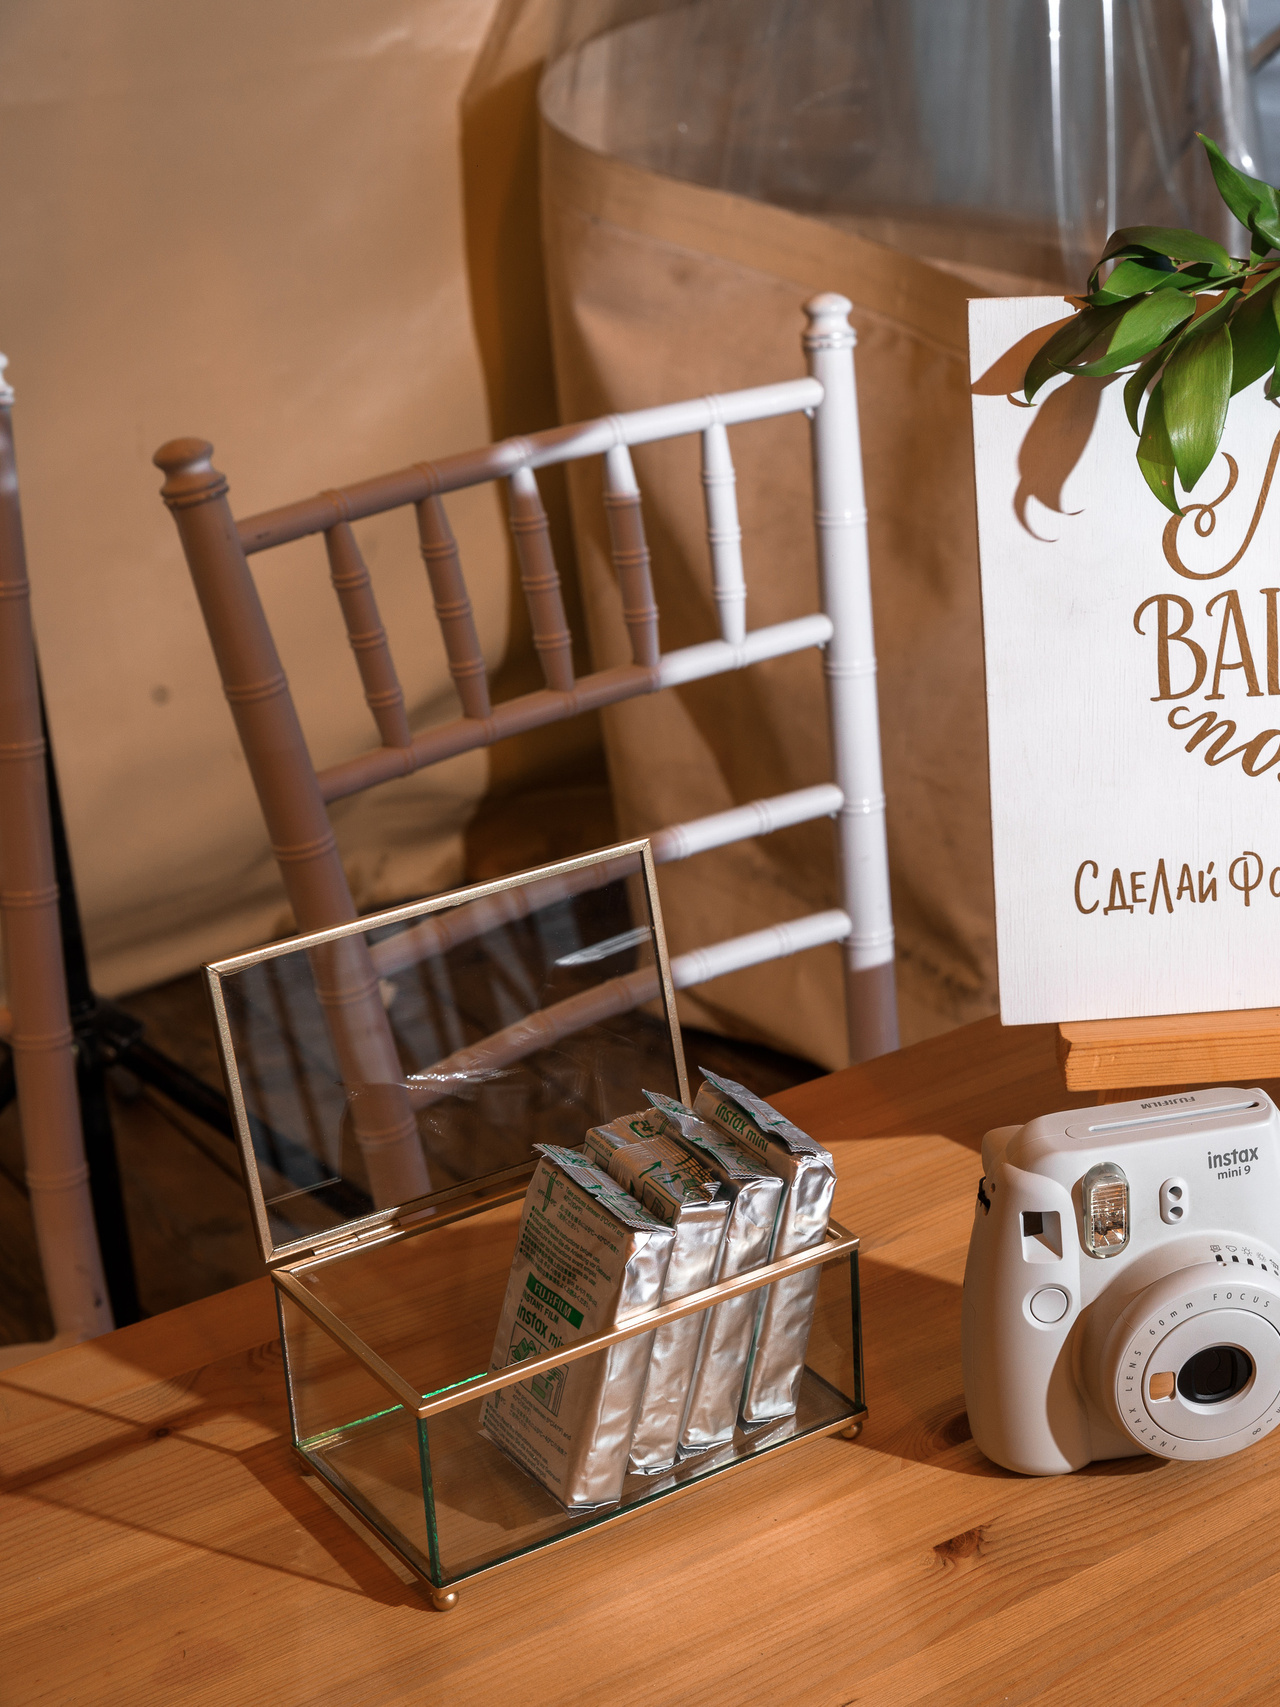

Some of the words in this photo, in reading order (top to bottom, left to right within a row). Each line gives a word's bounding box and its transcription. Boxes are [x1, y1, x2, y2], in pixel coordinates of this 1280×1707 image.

[1140, 1096, 1196, 1110] FUJIFILM
[715, 1101, 748, 1135] instax
[746, 1129, 772, 1153] mini
[1207, 1147, 1259, 1170] instax
[1217, 1166, 1242, 1180] mini
[1244, 1165, 1252, 1175] 9
[533, 1282, 572, 1319] FUJIFILM
[1213, 1292, 1270, 1309] FOCUS
[516, 1299, 548, 1339] instax
[544, 1308, 559, 1325] FILM
[1125, 1350, 1142, 1392] LENS
[1128, 1407, 1178, 1451] INSTAX
